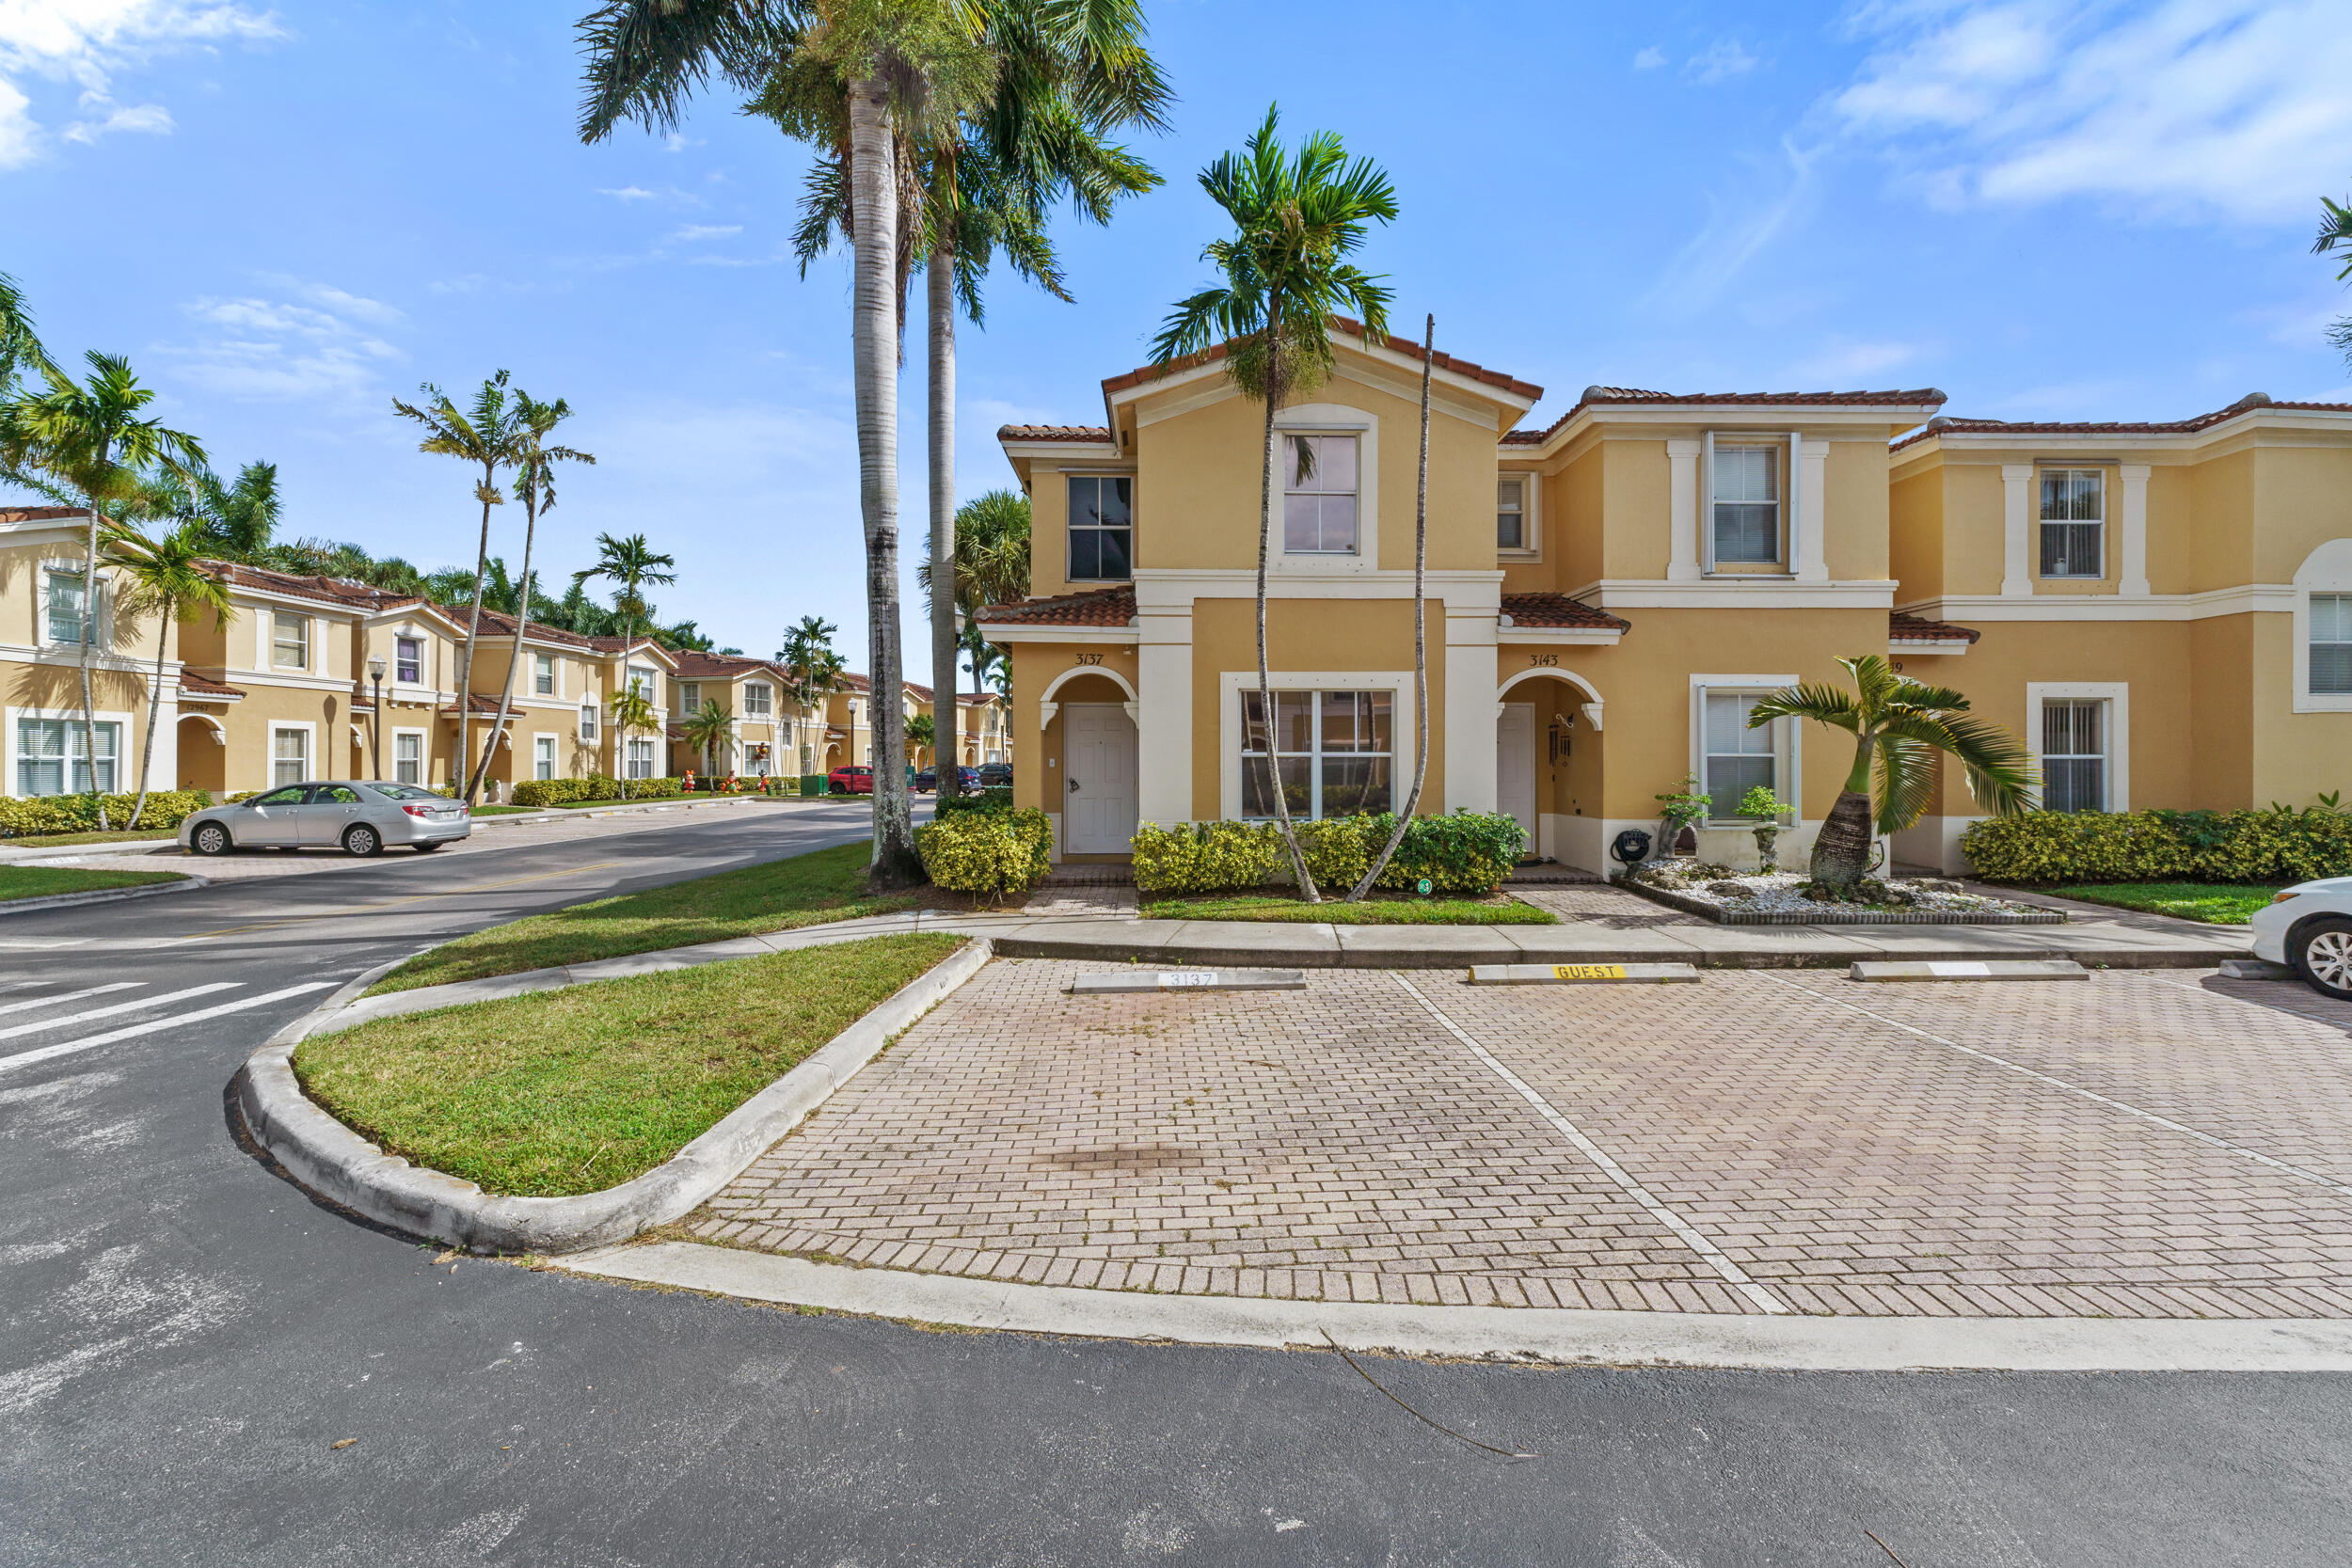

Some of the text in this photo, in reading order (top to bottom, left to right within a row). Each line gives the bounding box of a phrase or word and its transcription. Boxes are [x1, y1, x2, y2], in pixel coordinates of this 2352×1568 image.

[1075, 653, 1104, 665] 3137
[1530, 655, 1558, 666] 3143
[1558, 965, 1614, 978] GUEST
[1170, 973, 1213, 986] 3137
